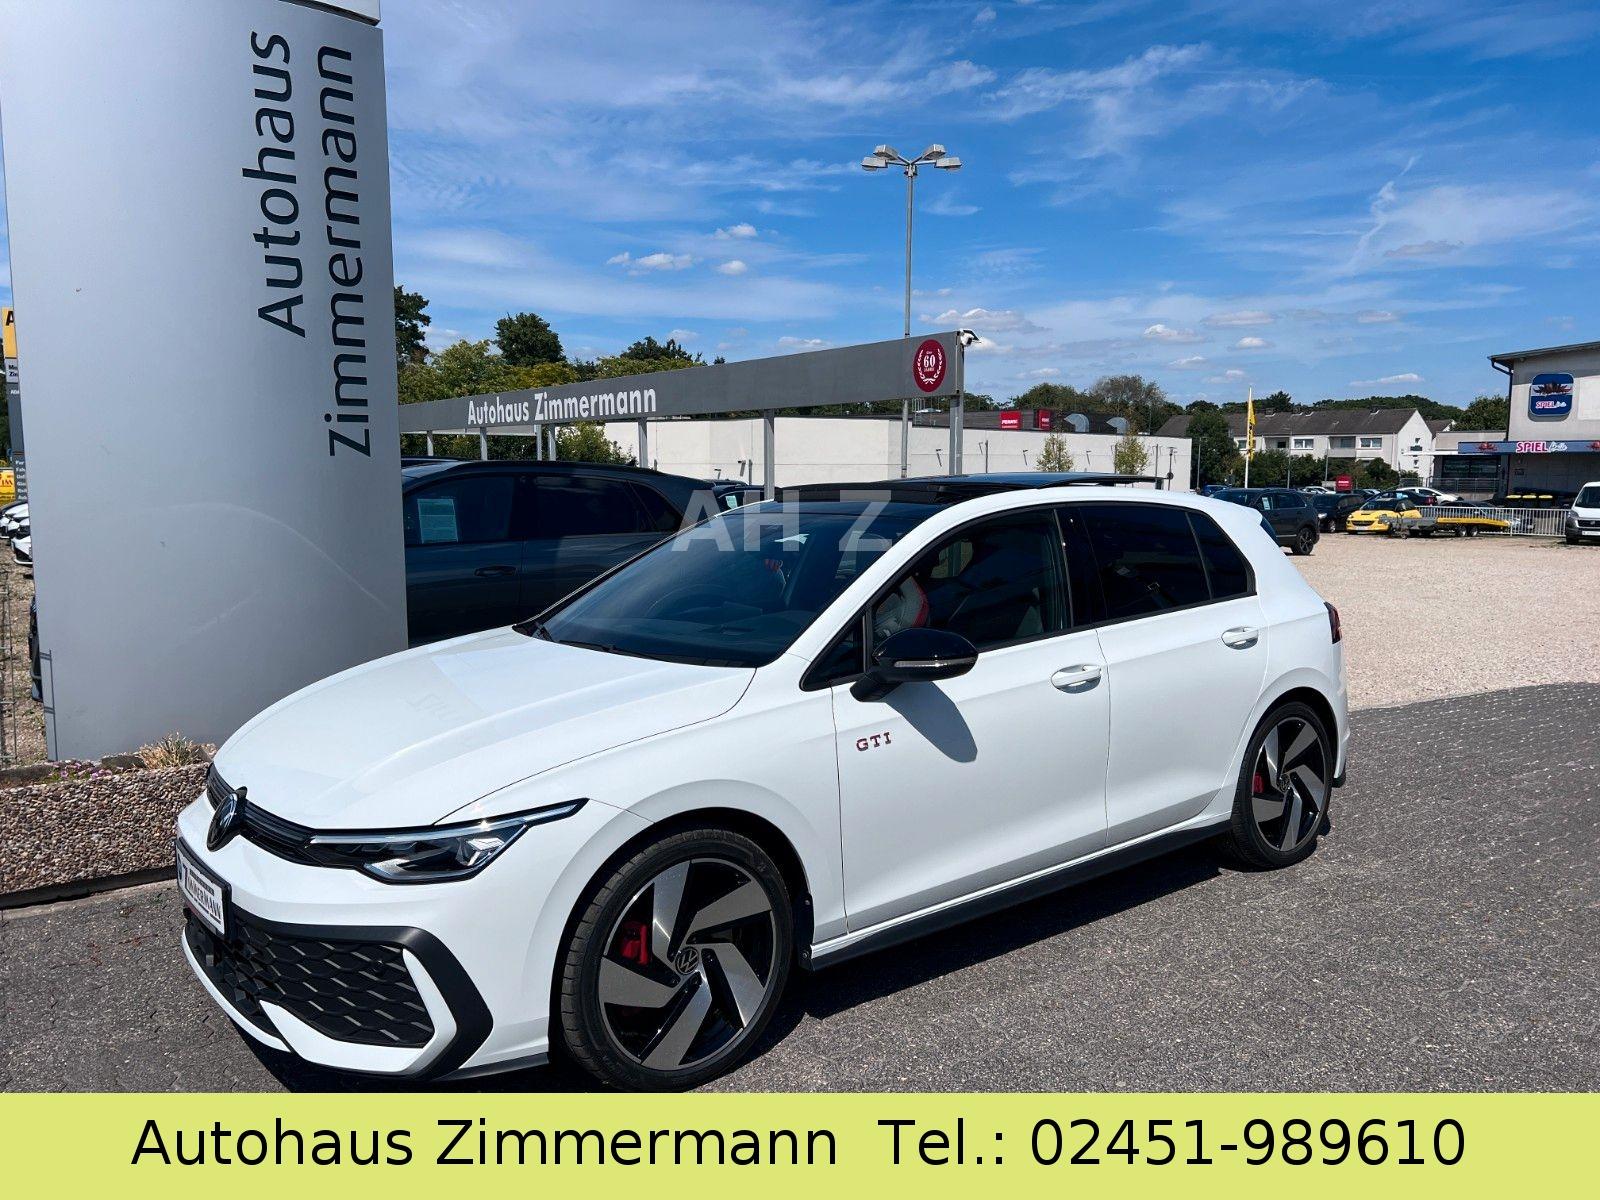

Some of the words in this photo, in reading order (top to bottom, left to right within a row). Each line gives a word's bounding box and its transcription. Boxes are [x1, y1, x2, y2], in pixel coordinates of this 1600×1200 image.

[242, 30, 306, 338] Autohaus
[317, 45, 371, 457] Zimmermann
[923, 354, 936, 368] 60
[467, 397, 529, 425] Autohaus
[534, 388, 657, 421] Zimmermann
[1516, 441, 1548, 453] SPIEL
[856, 731, 892, 752] GTI
